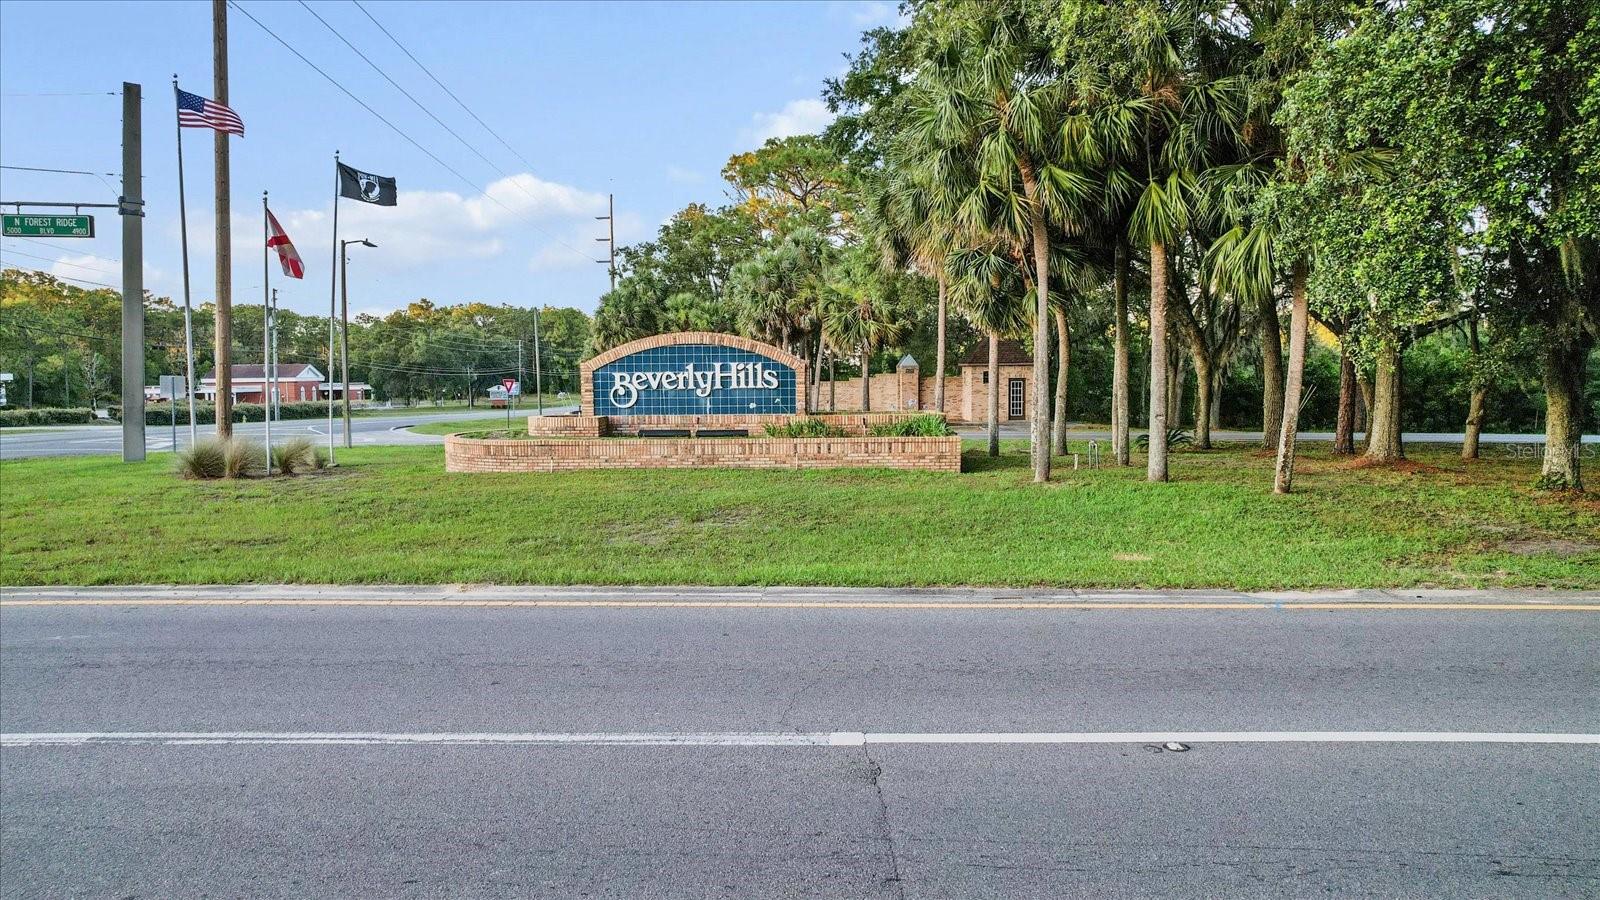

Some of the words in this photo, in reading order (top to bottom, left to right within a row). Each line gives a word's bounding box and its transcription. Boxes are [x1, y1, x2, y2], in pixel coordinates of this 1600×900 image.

[14, 217, 20, 226] N
[24, 217, 52, 227] FOREST
[56, 218, 78, 227] RIDGE
